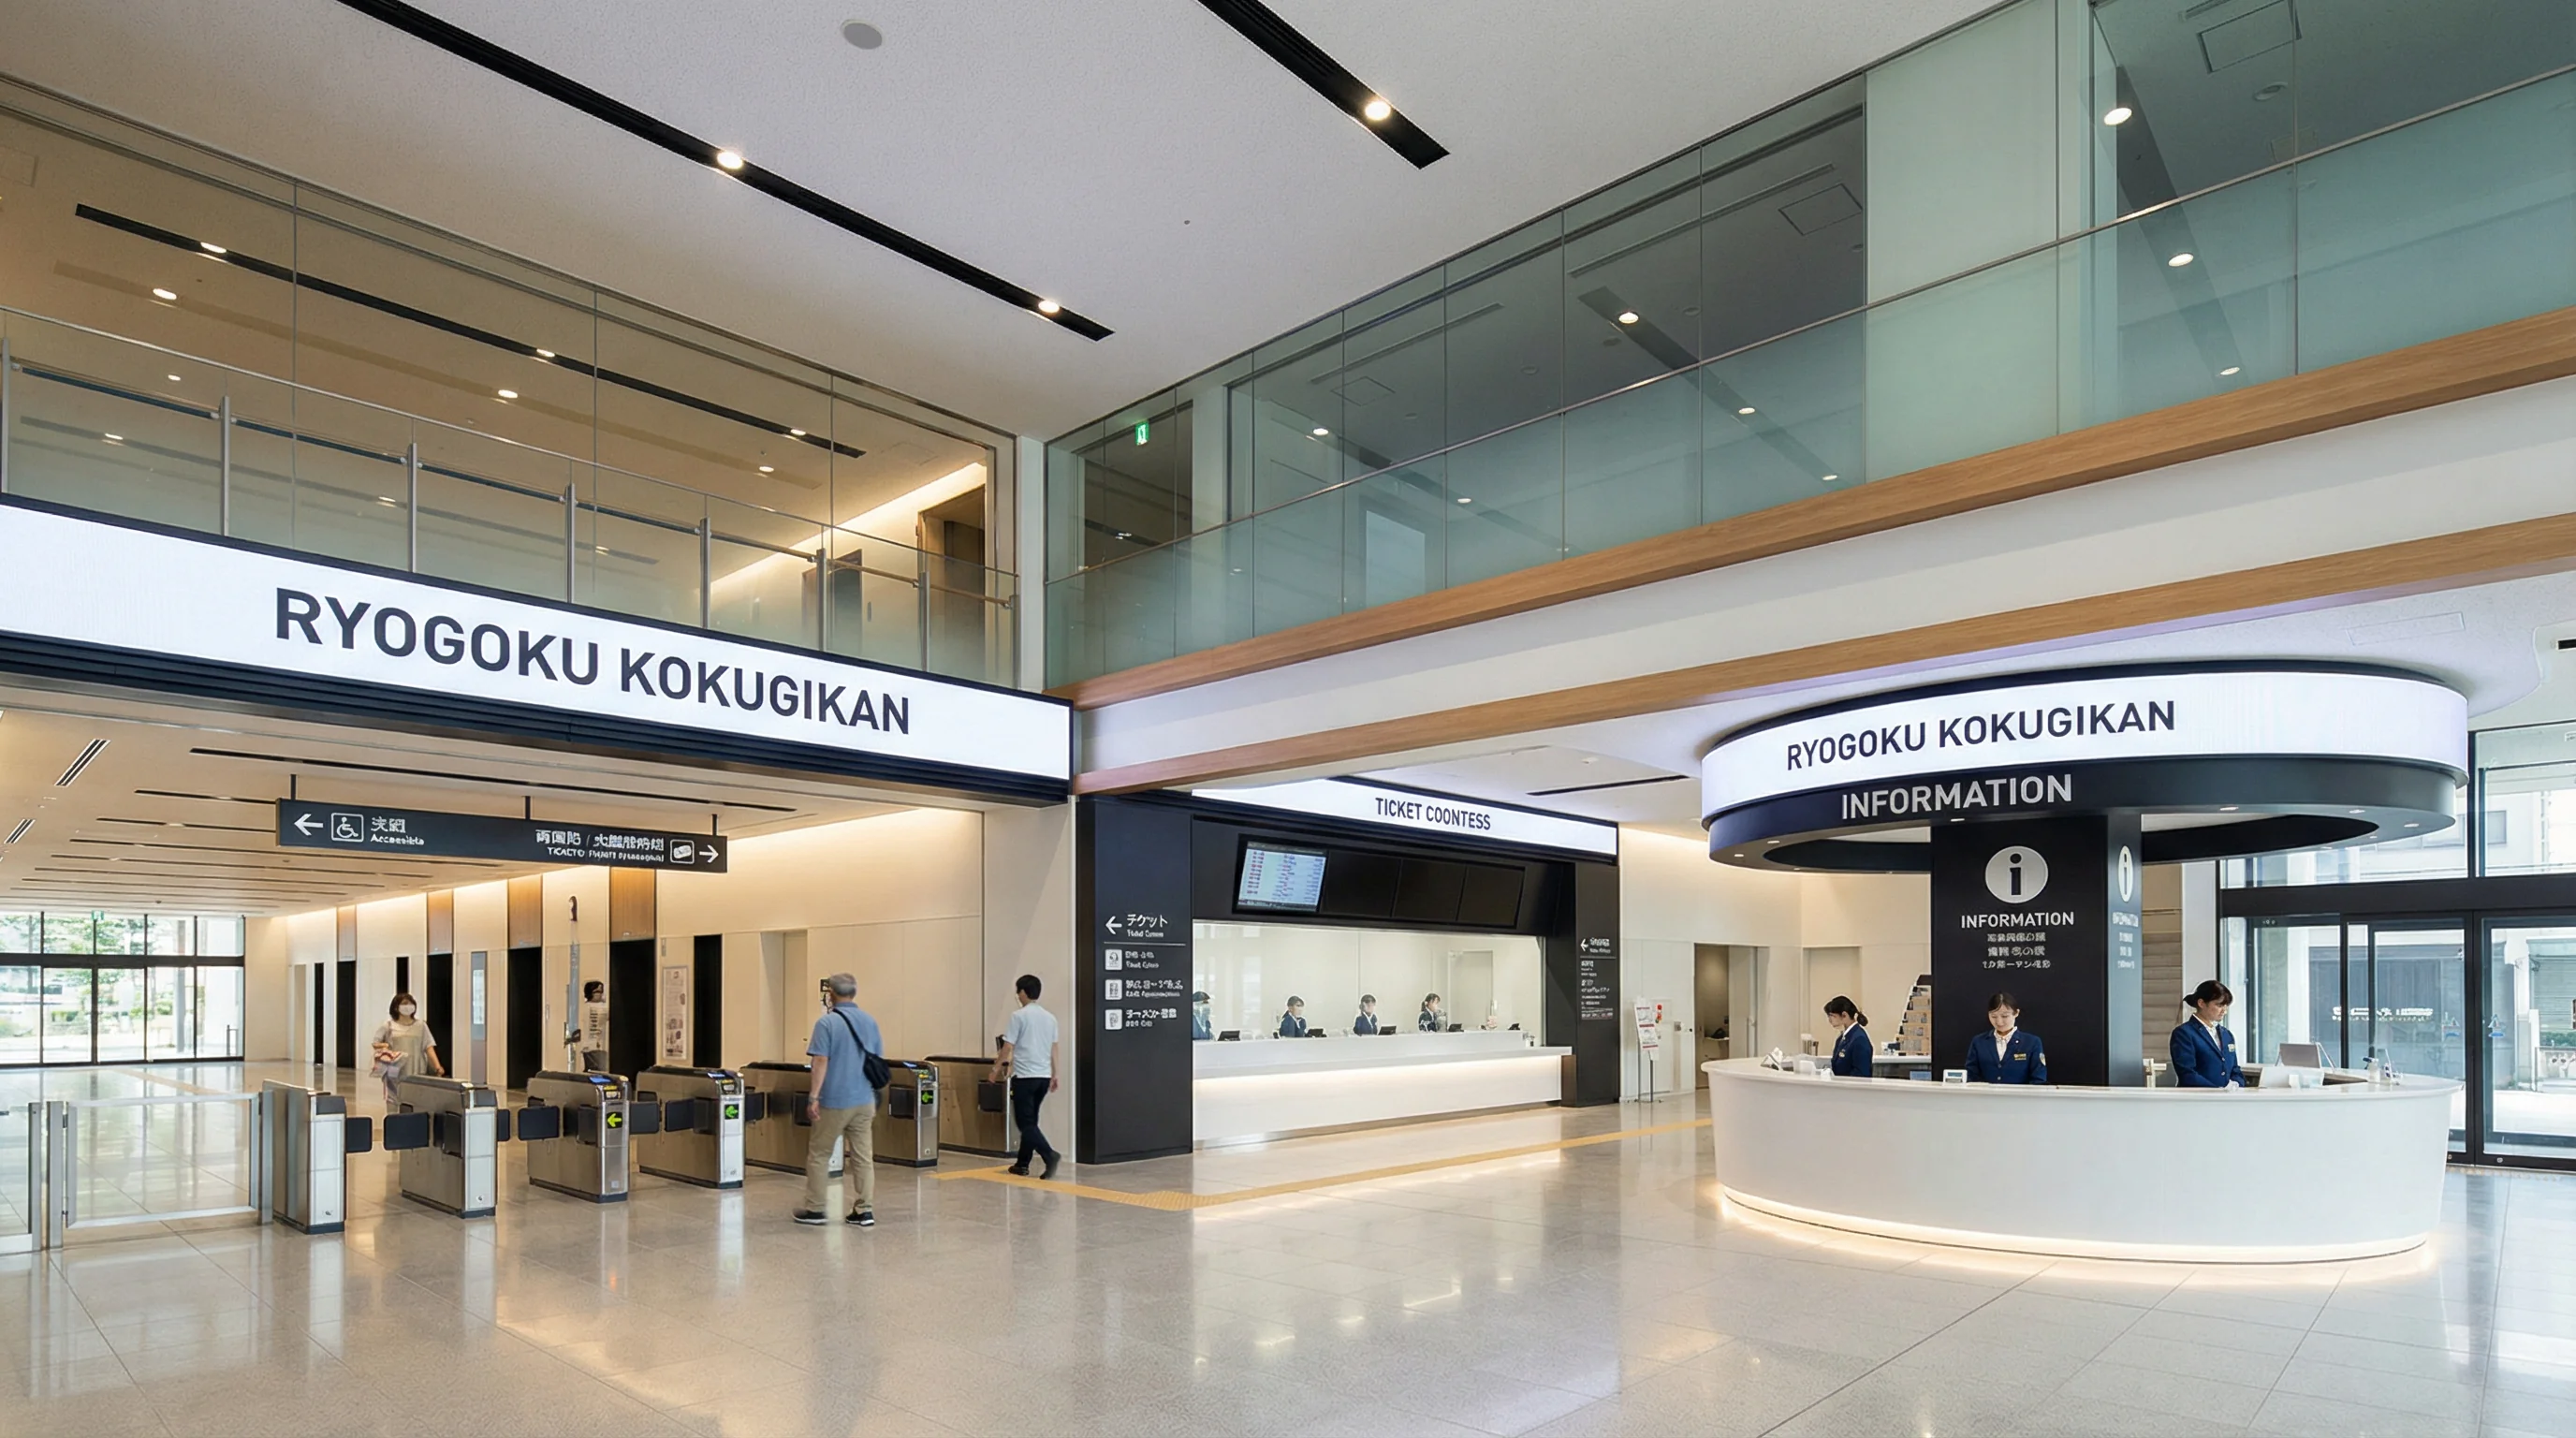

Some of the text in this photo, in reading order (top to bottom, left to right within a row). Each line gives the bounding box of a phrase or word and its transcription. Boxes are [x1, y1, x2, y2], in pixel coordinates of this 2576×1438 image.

[276, 587, 909, 735] RYOGOKU KOKUGIKAN
[1787, 700, 2174, 770] RYOGOKU KOKUGIKAN
[1375, 797, 1491, 830] TICKET COONTESS
[1841, 773, 2071, 820] INFORMATION
[1961, 911, 2074, 929] INFORMATION
